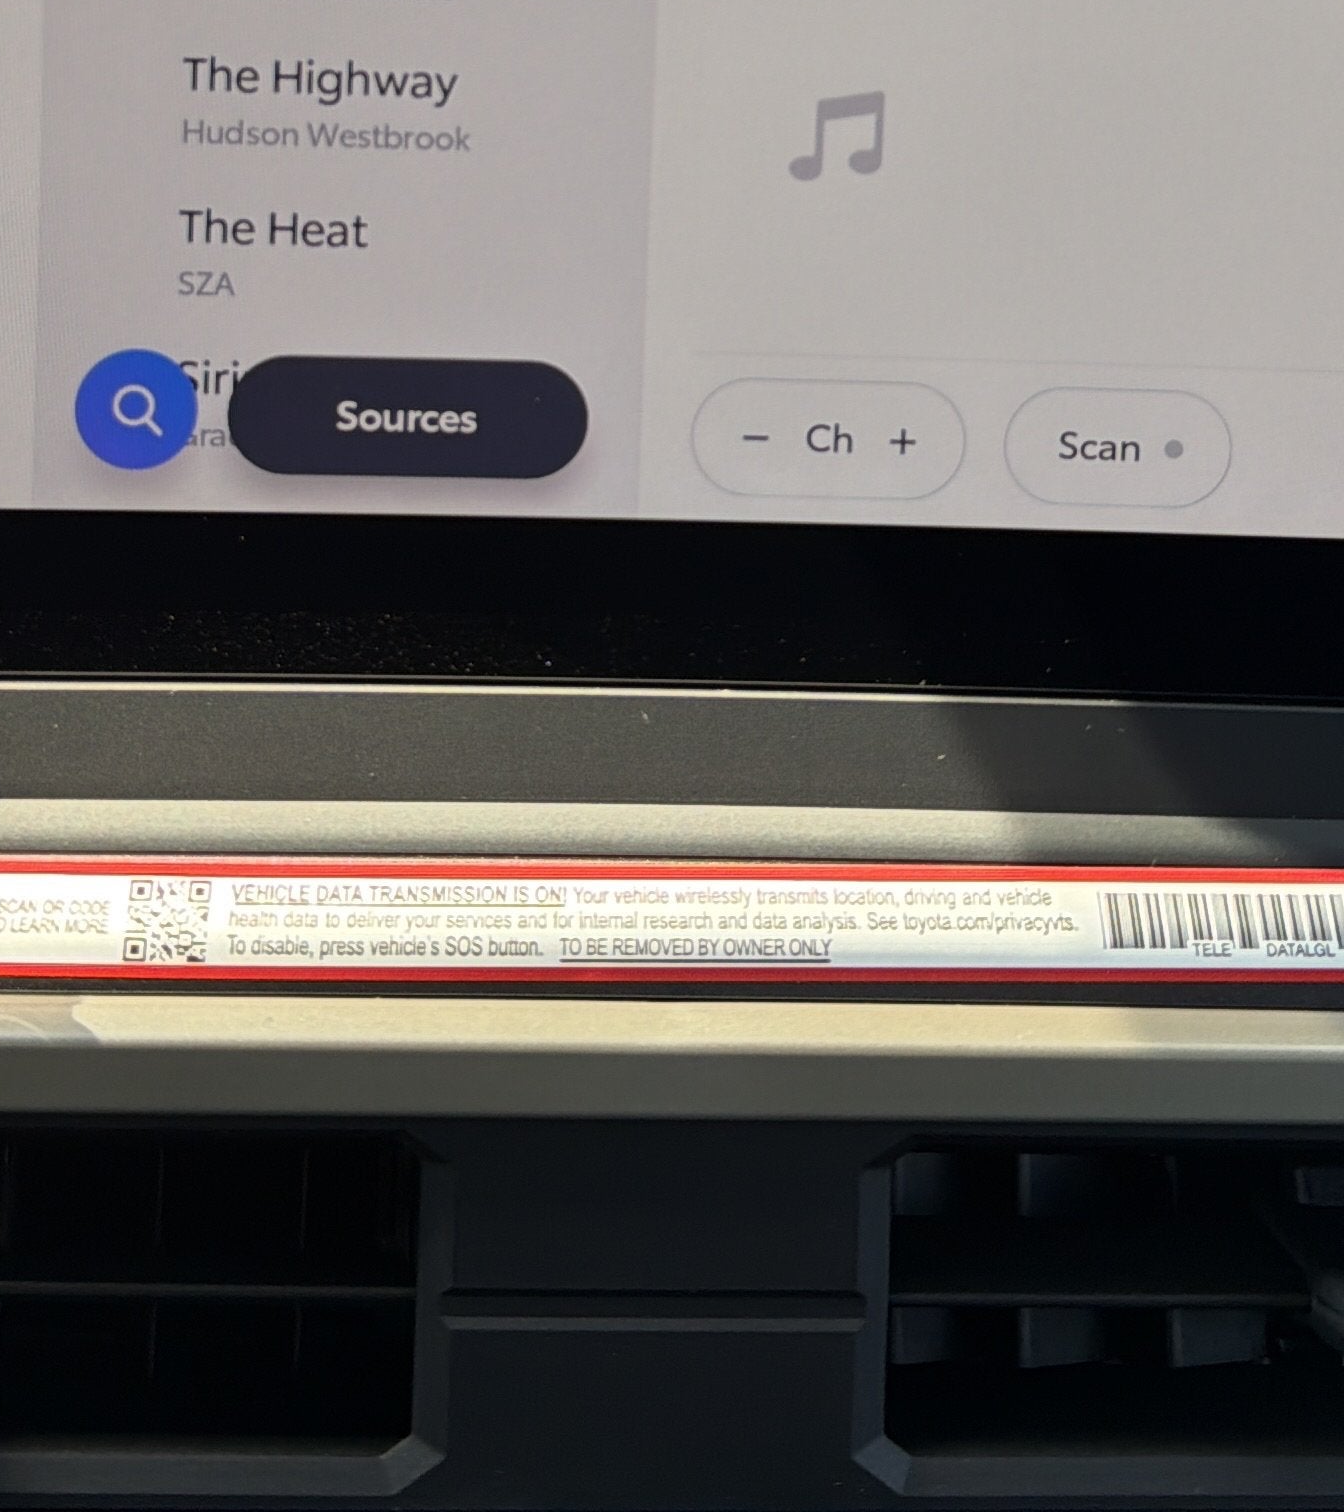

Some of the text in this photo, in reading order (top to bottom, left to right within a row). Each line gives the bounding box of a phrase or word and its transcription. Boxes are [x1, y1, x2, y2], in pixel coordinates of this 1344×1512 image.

[183, 56, 459, 107] The Highway
[182, 119, 471, 154] Hudson Westbrook
[179, 209, 370, 249] The Heat
[178, 270, 237, 298] SZA
[335, 400, 479, 436] Sources
[806, 423, 854, 455] Ch
[1058, 431, 1143, 464] Scan
[231, 884, 1054, 910] VEHICLE DATA TRANSMISSION IS ON! Your vehicle wirelessly transmits location, driving and vehicle
[10, 917, 60, 934] LEARN
[64, 918, 110, 935] MORE
[228, 910, 279, 928] health
[283, 911, 319, 929] data
[325, 912, 341, 929] to
[346, 910, 400, 929] deliver
[404, 915, 441, 934] your
[445, 913, 513, 929] services
[517, 912, 549, 930] and
[553, 911, 575, 930] for
[578, 911, 639, 930] internal
[643, 912, 714, 930] research
[717, 912, 748, 931] and
[752, 912, 789, 931] data
[792, 912, 862, 934] analysis.
[866, 912, 899, 931] See
[227, 934, 833, 960] To disable, press vehicle's SOS button. TO BE REMOVED BY OWNER ONLY
[1191, 942, 1233, 958] TELE
[1266, 942, 1337, 959] DATALGL
